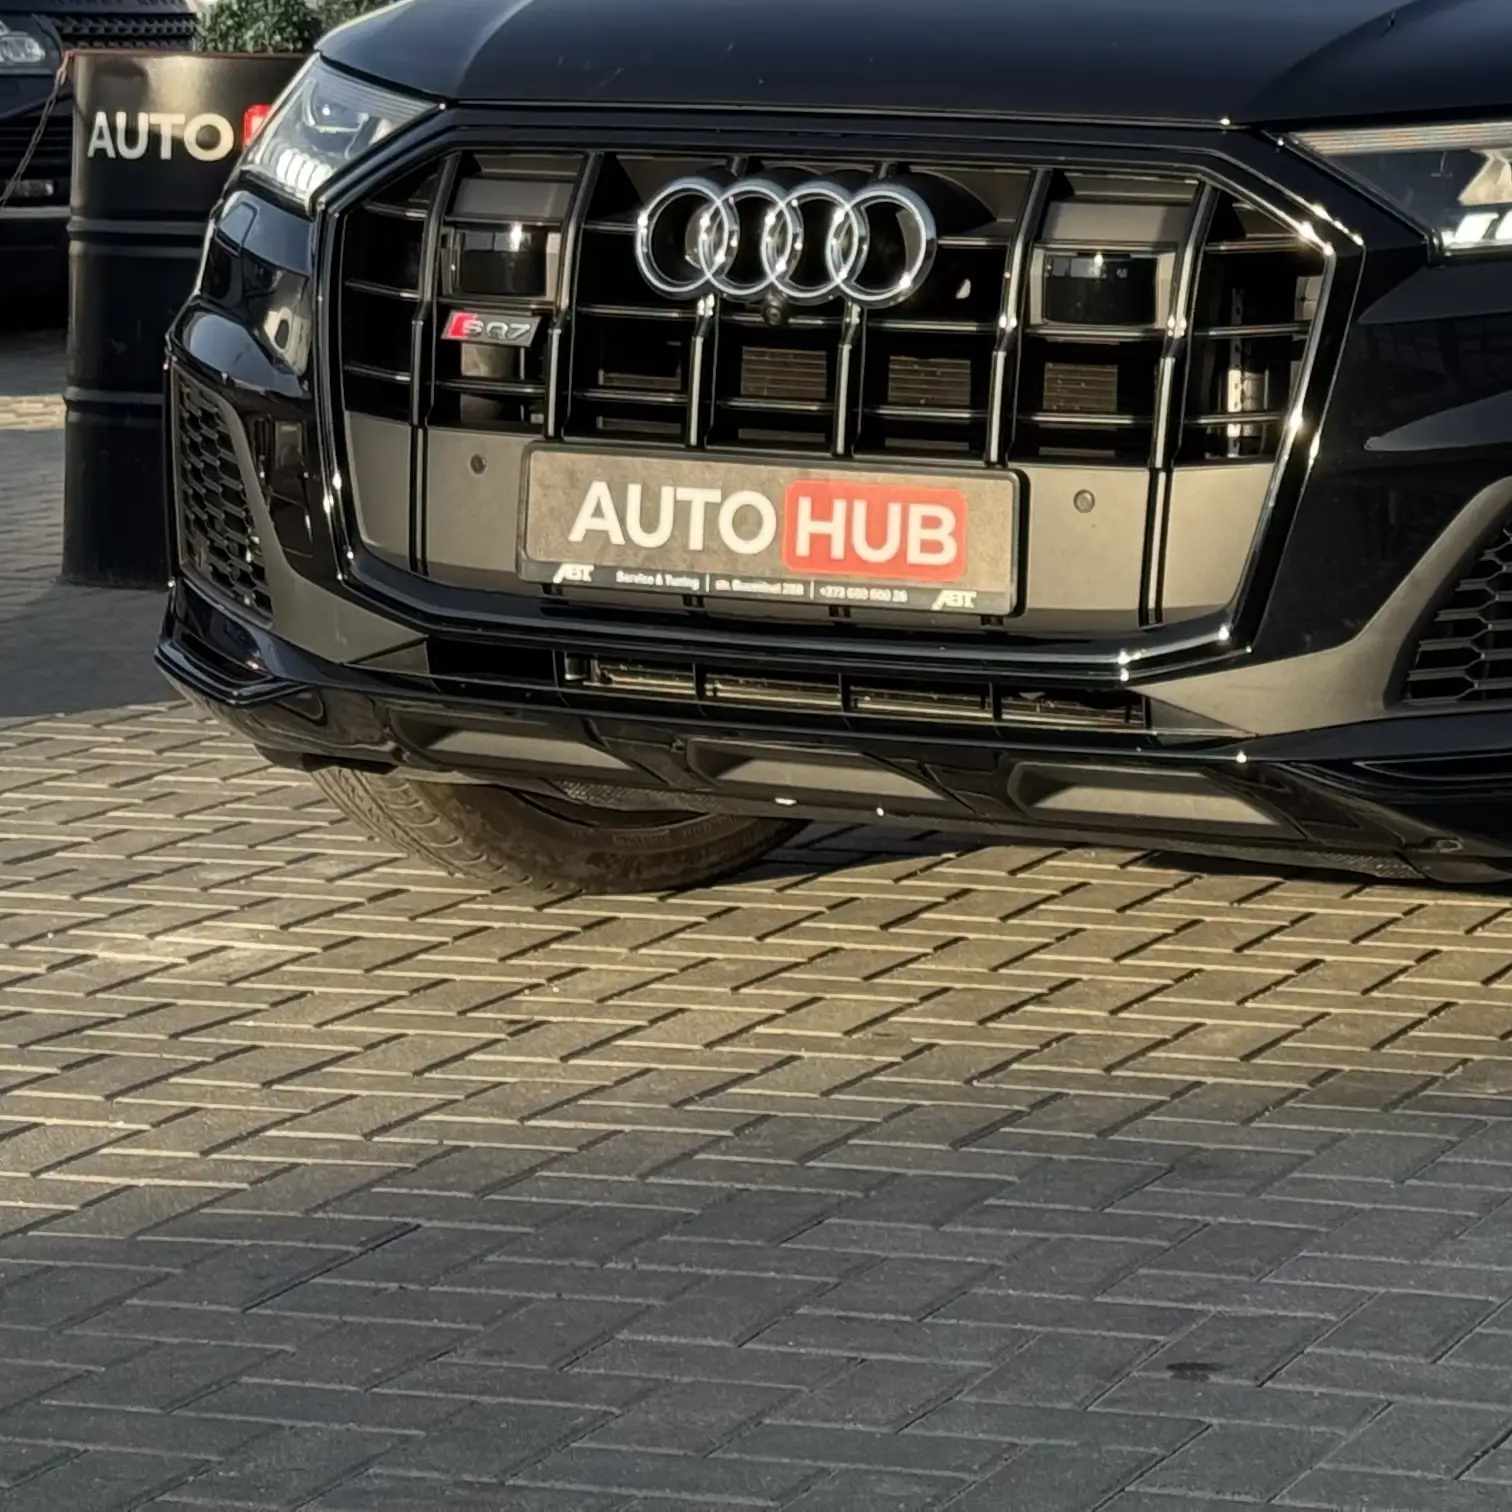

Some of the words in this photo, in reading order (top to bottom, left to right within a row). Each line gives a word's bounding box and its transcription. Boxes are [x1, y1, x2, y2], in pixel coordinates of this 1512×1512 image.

[87, 110, 235, 162] AUTO
[568, 480, 778, 555] AUTO
[794, 496, 958, 566] HUB
[552, 563, 595, 584] ABT
[932, 590, 977, 611] ABT
